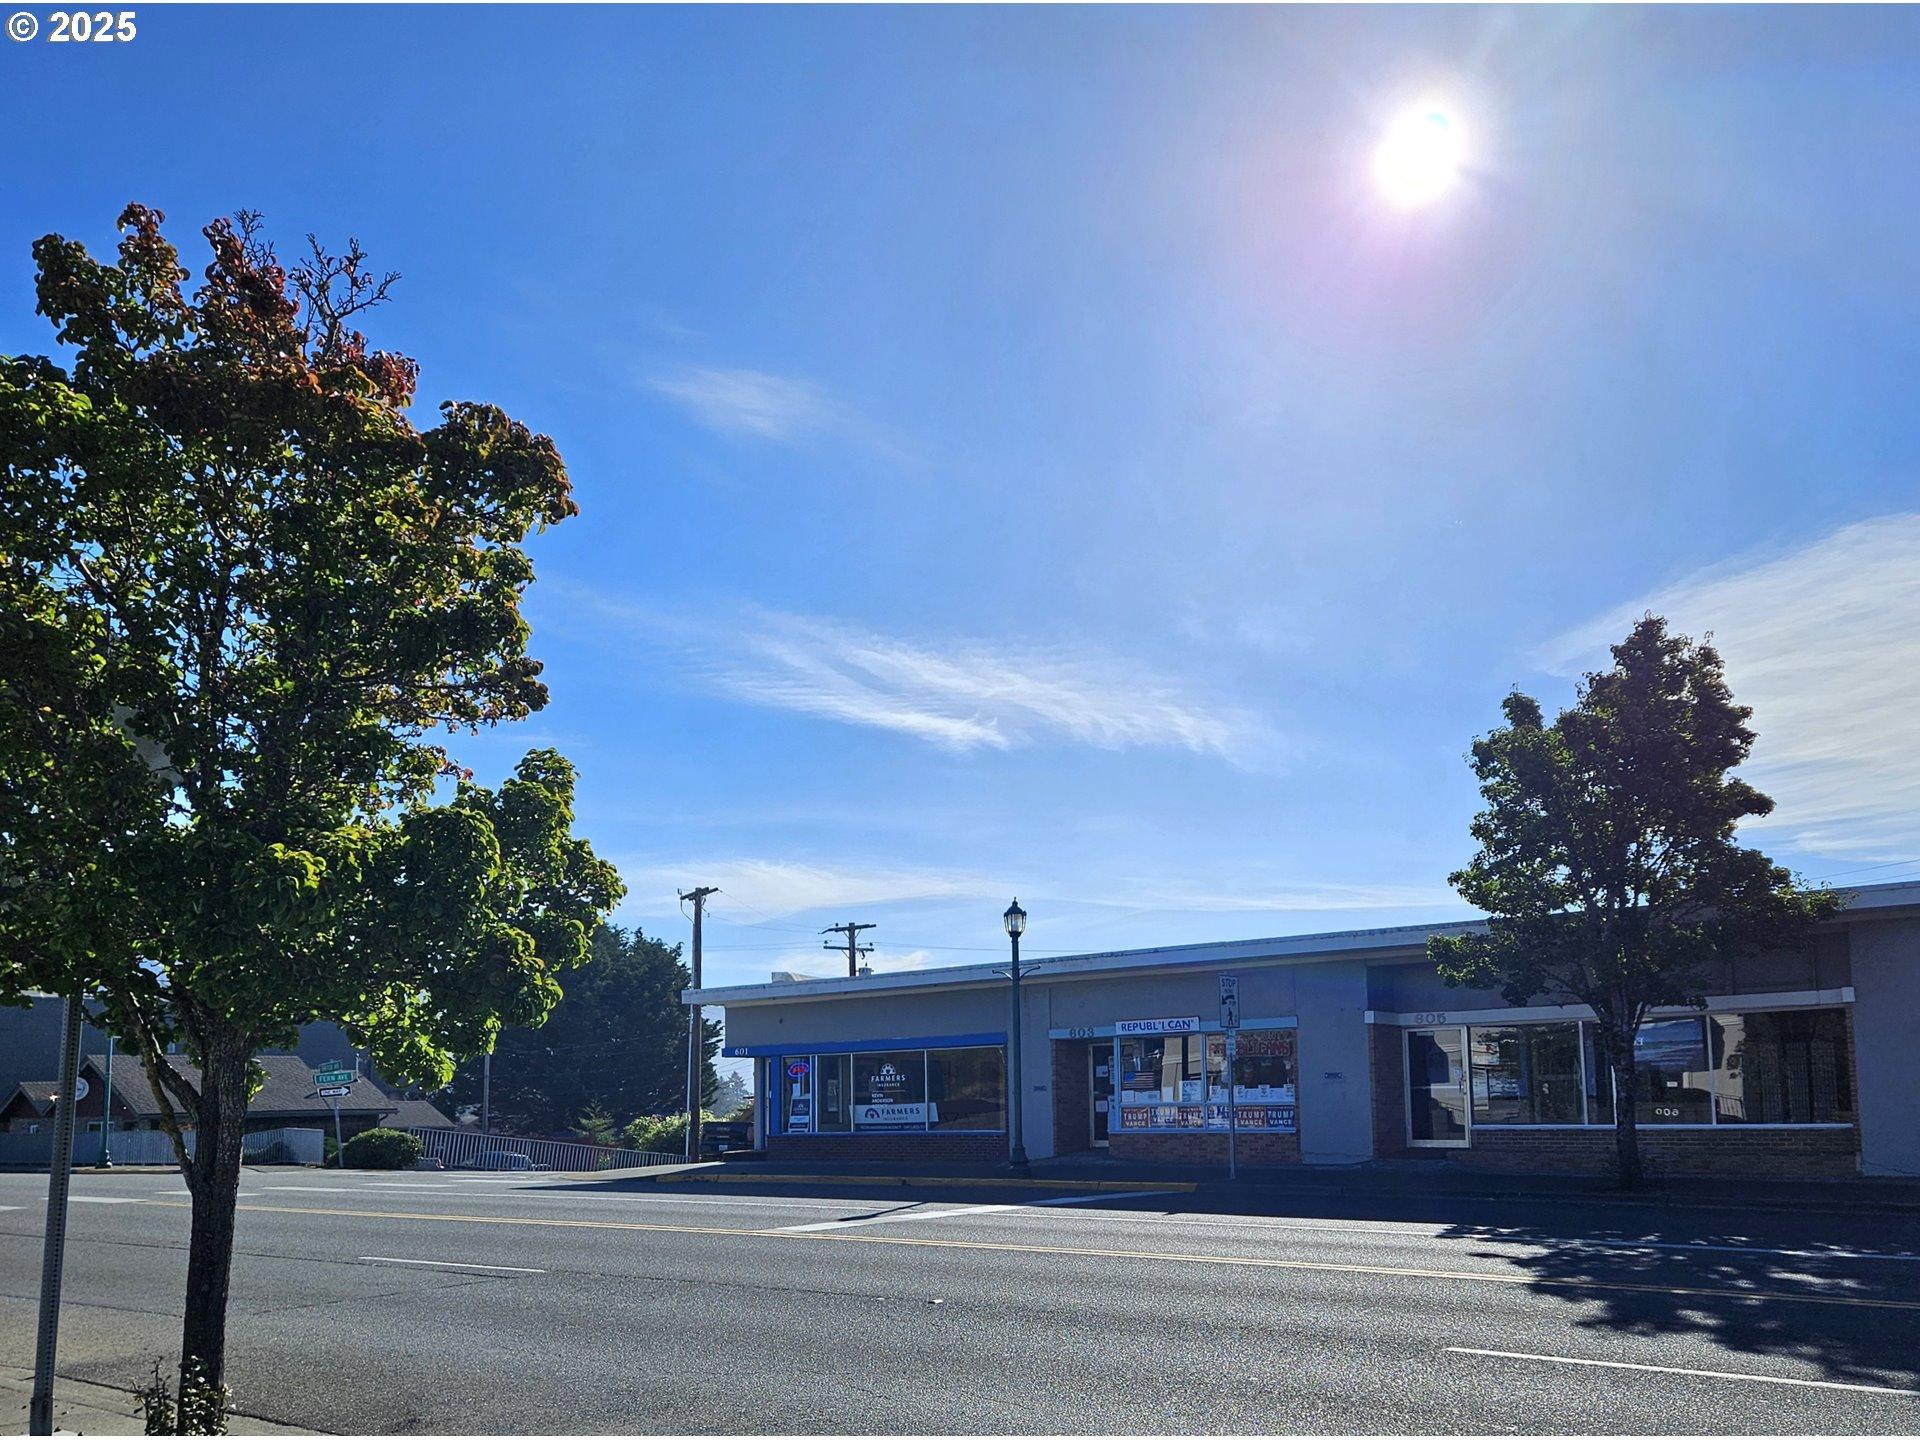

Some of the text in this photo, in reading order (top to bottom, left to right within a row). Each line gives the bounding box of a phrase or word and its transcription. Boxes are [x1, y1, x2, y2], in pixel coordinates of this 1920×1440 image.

[1221, 978, 1236, 988] STOP
[734, 1047, 748, 1056] 601
[871, 1074, 906, 1082] FARMERS
[881, 1106, 920, 1115] FARMERS
[1151, 1107, 1176, 1117] TRUMP
[1238, 1110, 1265, 1119] TRUMP
[1267, 1110, 1294, 1119] TRUMP
[1123, 1111, 1148, 1120] TRUMP
